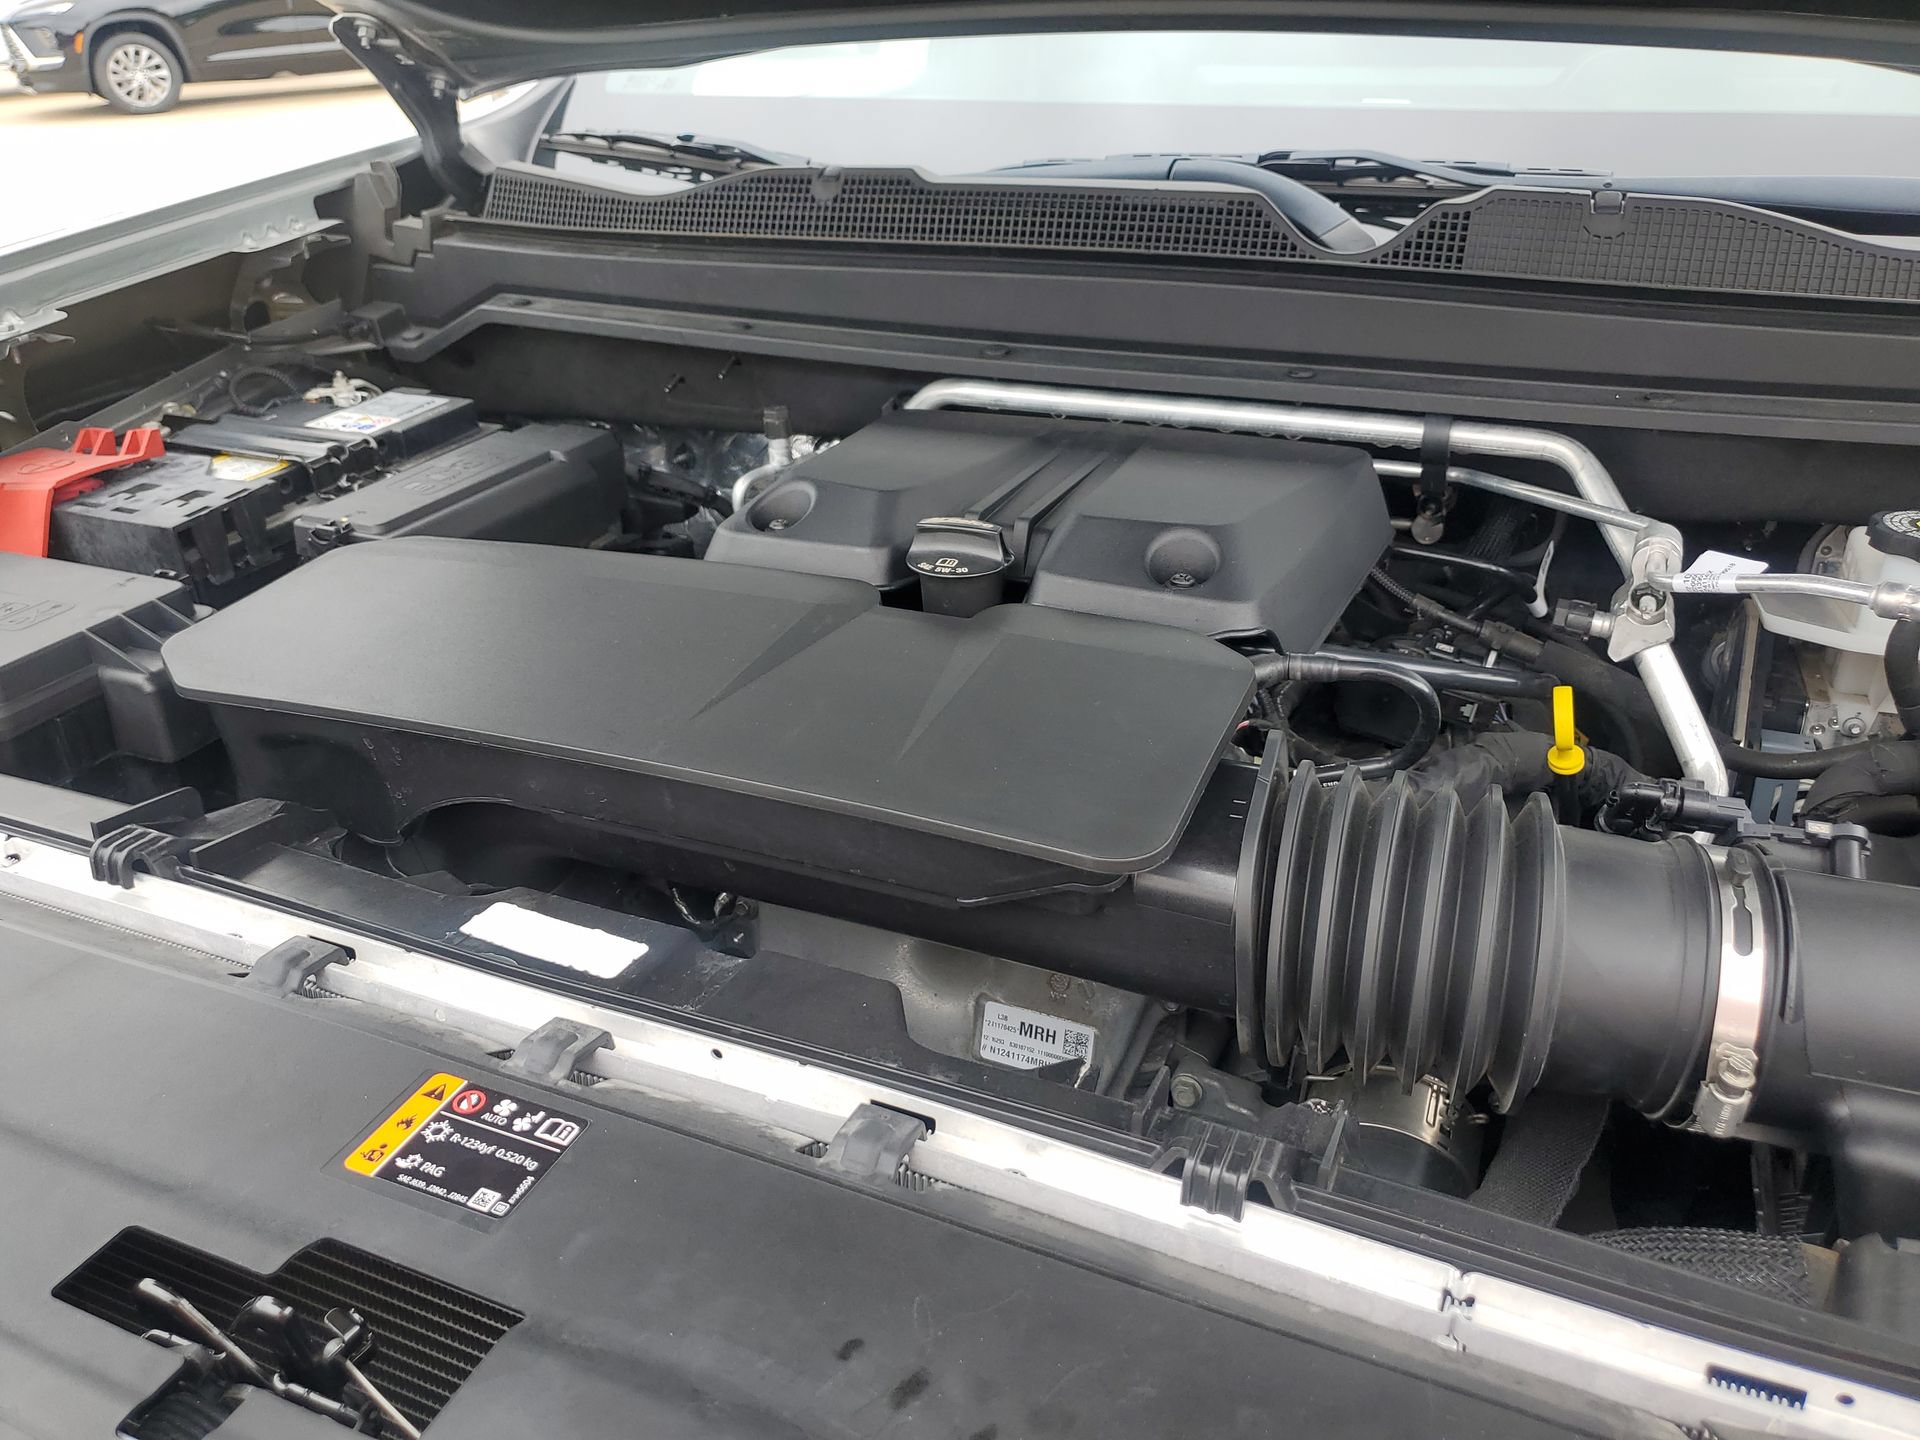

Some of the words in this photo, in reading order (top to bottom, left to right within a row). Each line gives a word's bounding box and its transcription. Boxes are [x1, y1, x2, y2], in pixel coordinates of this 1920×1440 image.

[1019, 1021, 1057, 1045] MRH
[481, 1112, 507, 1125] AUTO
[449, 1132, 497, 1155] R-1234yf
[495, 1148, 525, 1165] 0.520
[522, 1156, 538, 1171] kg
[419, 1161, 446, 1178] PAG
